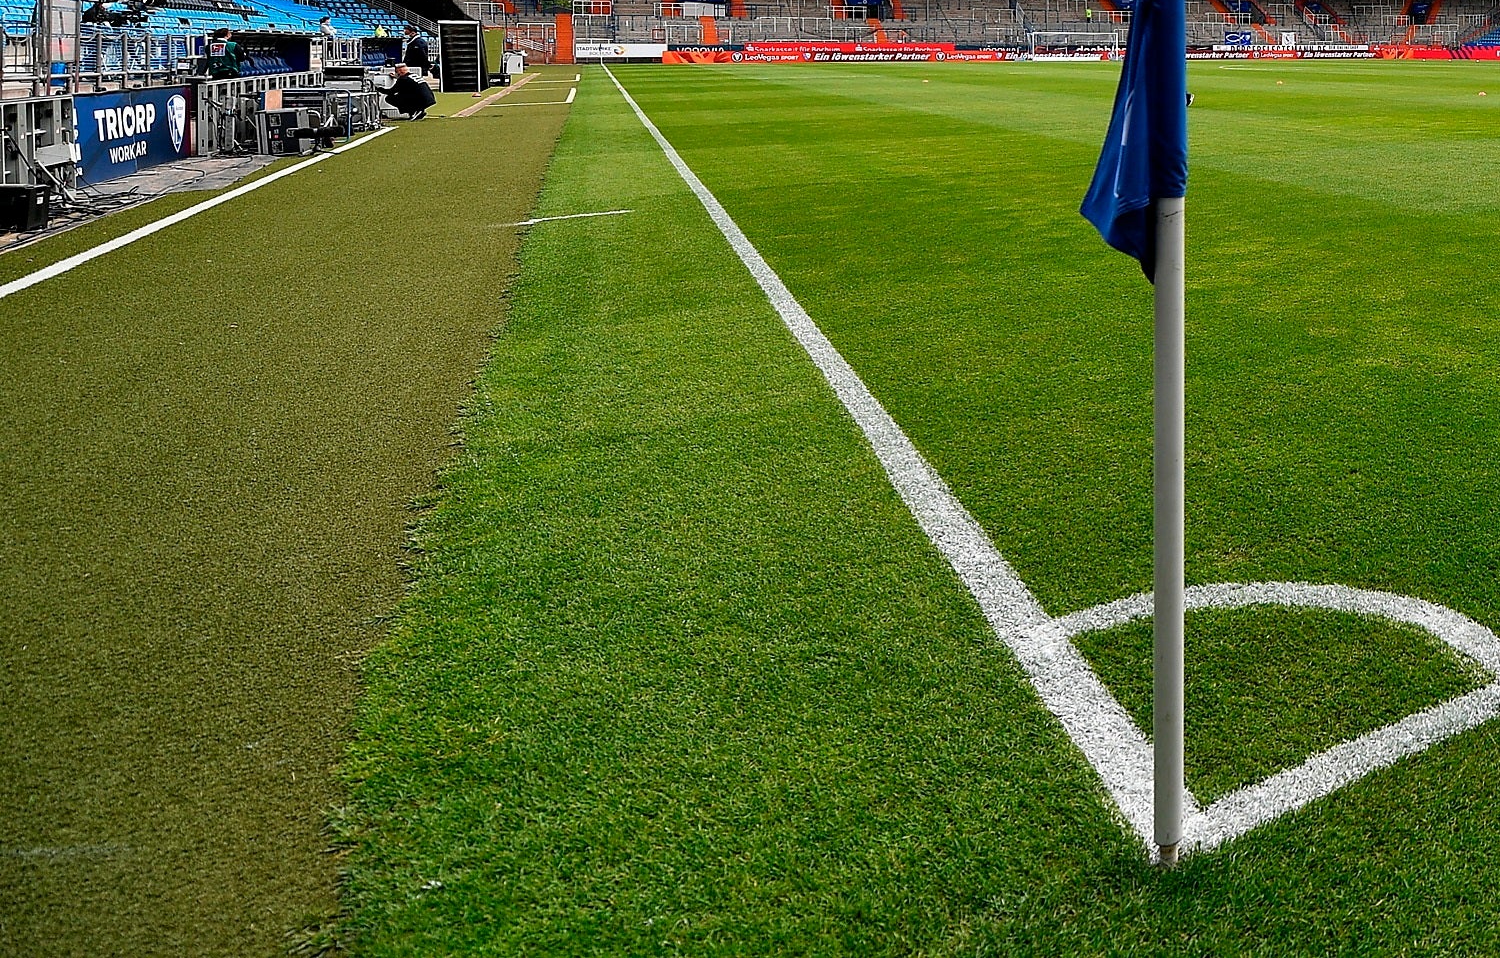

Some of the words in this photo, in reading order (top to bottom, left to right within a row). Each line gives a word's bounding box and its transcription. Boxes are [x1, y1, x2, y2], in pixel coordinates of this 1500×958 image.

[744, 53, 780, 62] LeoVegas
[813, 52, 830, 61] Ein
[831, 52, 893, 61] löwenstarker
[894, 52, 931, 61] Partner
[1004, 52, 1019, 60] Ein
[1185, 51, 1224, 59] wenstarker
[1224, 51, 1250, 59] Partner
